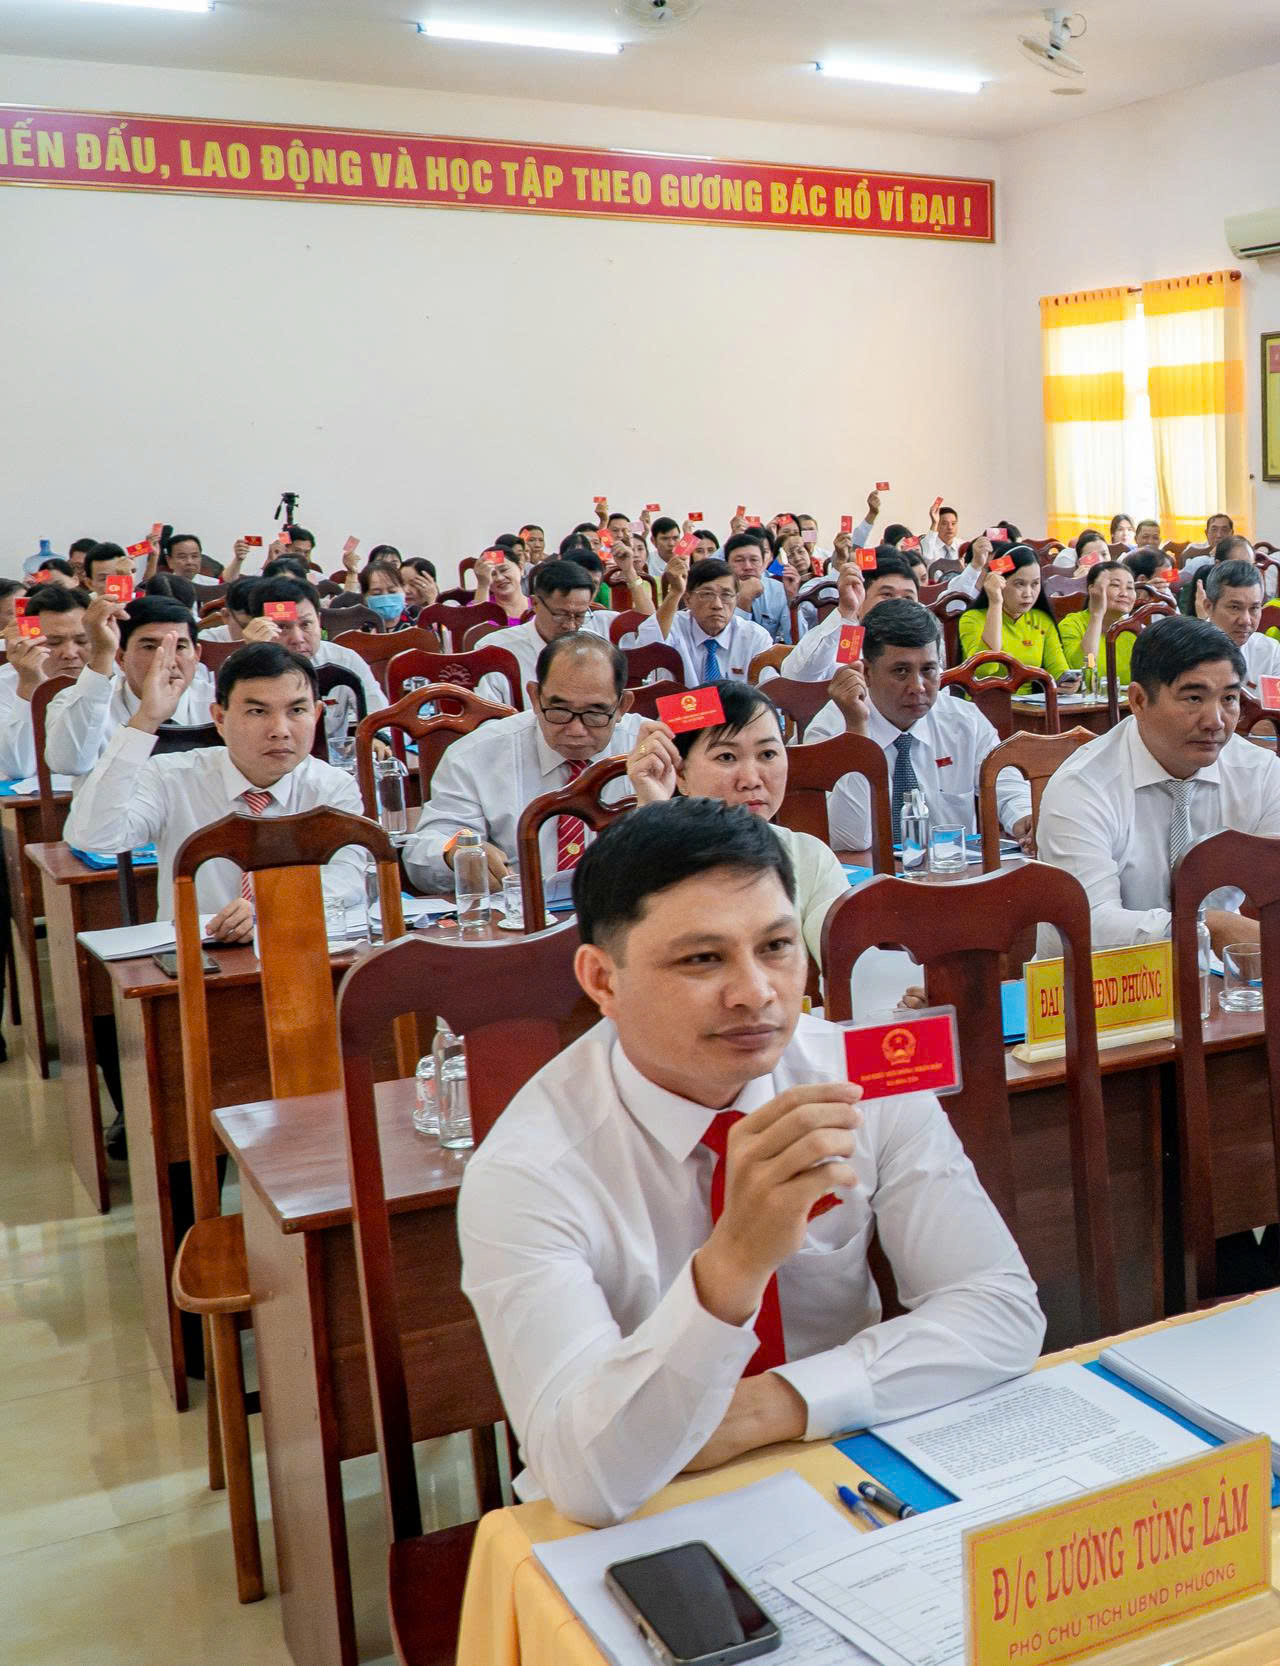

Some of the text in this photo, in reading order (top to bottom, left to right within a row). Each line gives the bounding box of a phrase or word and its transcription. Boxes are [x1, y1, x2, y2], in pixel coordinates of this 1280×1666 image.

[76, 120, 170, 179] ĐẤU,
[180, 139, 250, 179] LAO
[260, 139, 362, 190] ĐỘNG
[371, 146, 418, 190] VÀ
[426, 155, 493, 200] HỌC
[501, 157, 564, 205] TẬP
[571, 166, 651, 206] THEO
[659, 173, 764, 213] GƯƠNG
[770, 177, 827, 217] BÁC
[835, 178, 871, 220] HỒ
[877, 185, 905, 222] VĨ
[911, 192, 955, 231] ĐẠI
[992, 1556, 1038, 1627] Đ/c
[1045, 1527, 1125, 1602] LƯƠNG
[1133, 1500, 1196, 1571] TÙNG
[1203, 1476, 1249, 1546] LÂM
[1128, 1588, 1169, 1617] UBND
